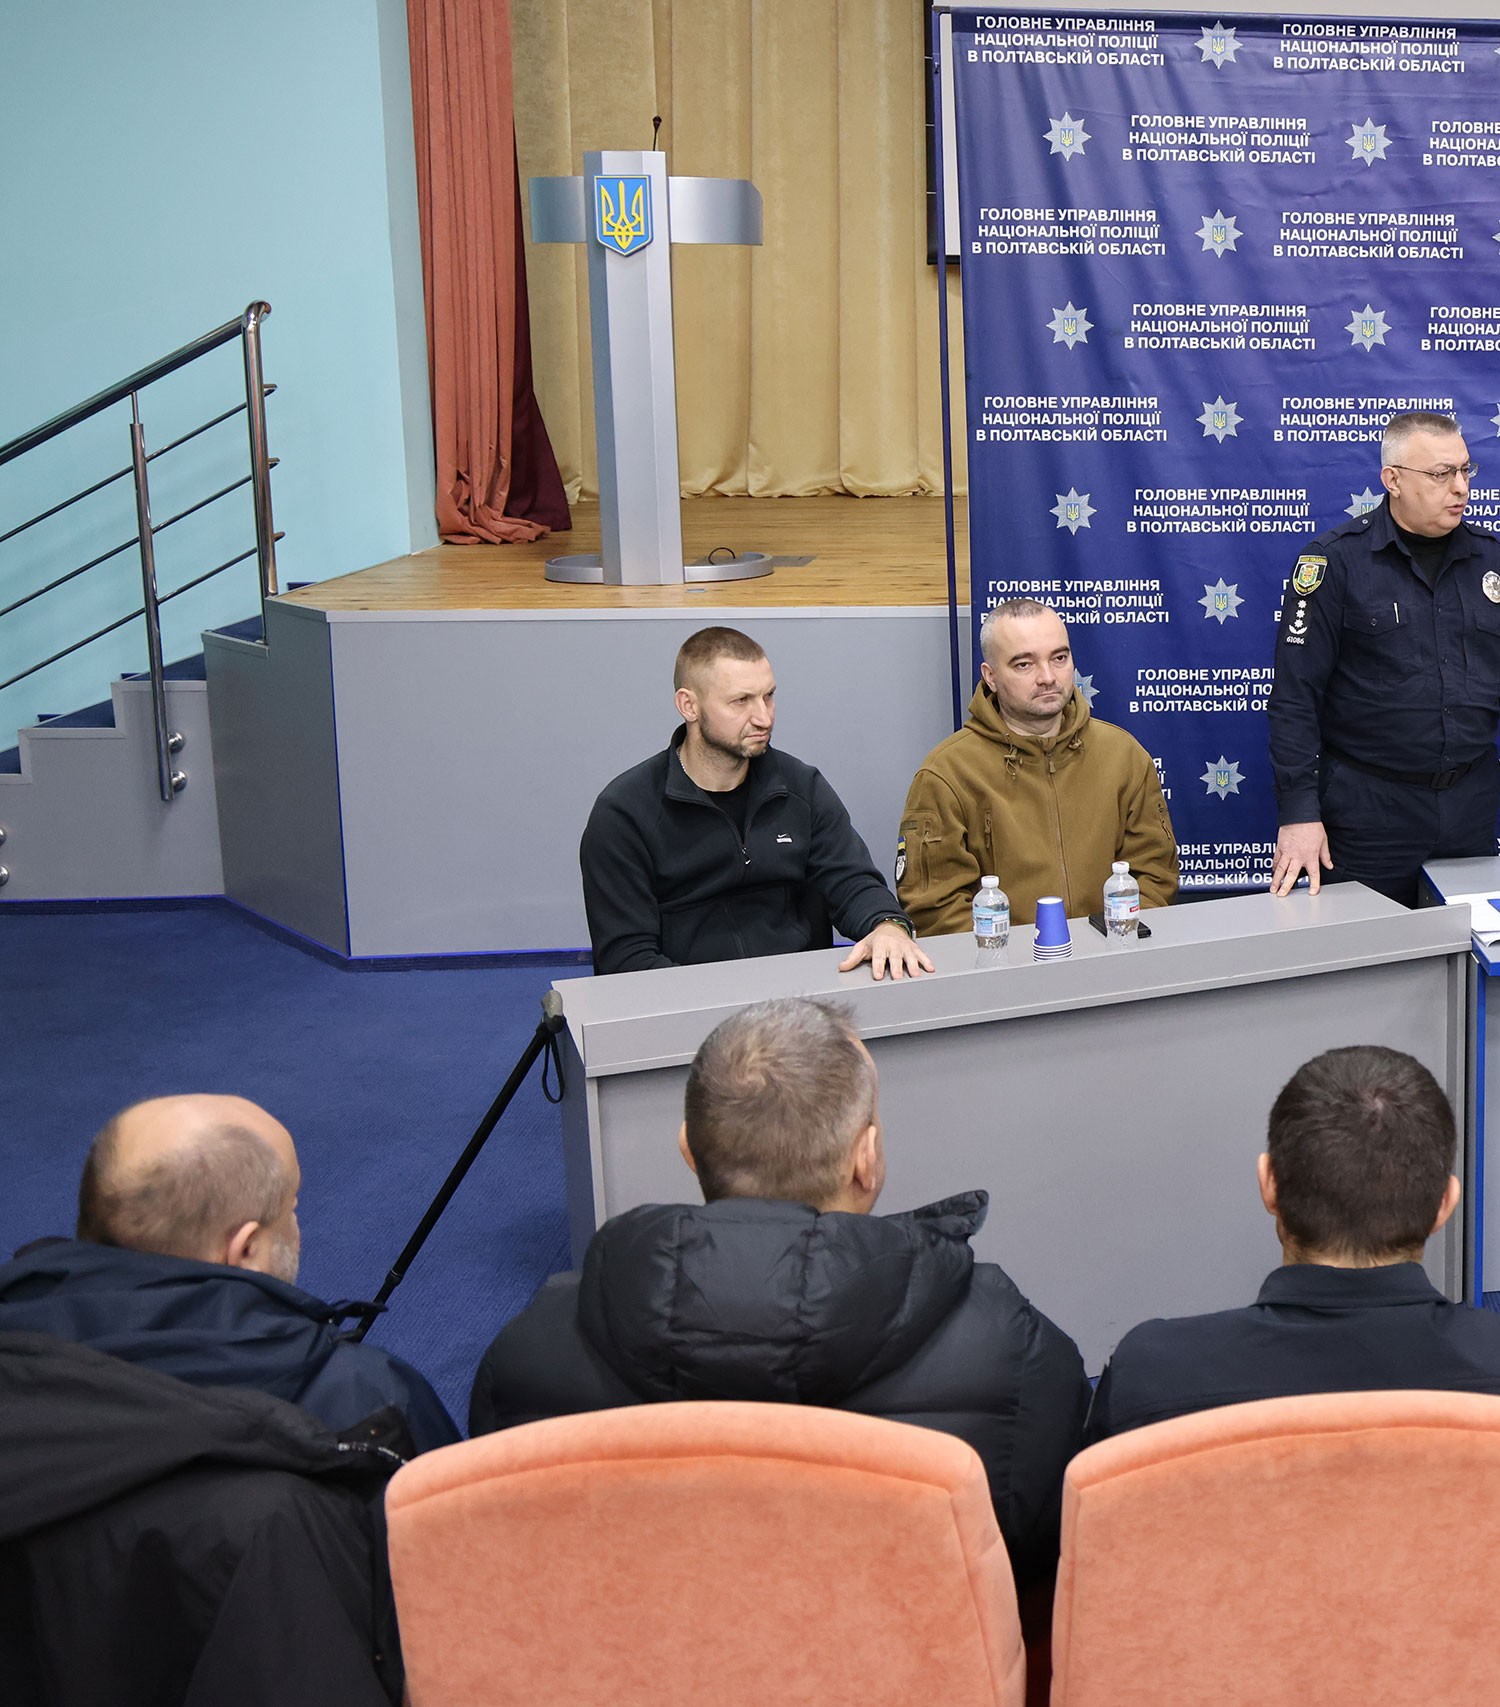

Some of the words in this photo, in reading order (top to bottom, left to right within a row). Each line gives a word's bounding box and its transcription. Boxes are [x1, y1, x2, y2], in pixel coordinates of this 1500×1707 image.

[976, 16, 1052, 29] ГОЛОВНЕ
[1055, 18, 1155, 32] УПРАВЛІННЯ
[1283, 24, 1356, 37] ГОЛОВНЕ
[1360, 26, 1456, 39] УПРАВЛІННЯ
[974, 33, 1096, 48] НАЦІОНАЛЬНОЇ
[1098, 34, 1159, 51] ПОЛІЦІЇ
[1280, 40, 1398, 55] НАЦІОНАЛЬНОЇ
[1400, 42, 1460, 58] ПОЛІЦІЇ
[968, 50, 978, 62] В
[982, 49, 1093, 64] ПОЛТАВСЬКІЙ
[1096, 52, 1164, 66] ОБЛАСТІ
[1273, 56, 1284, 68] В
[1287, 56, 1396, 71] ПОЛТАВСЬКІЙ
[1398, 59, 1465, 73] ОБЛАСТІ
[1131, 114, 1206, 128] ГОЛОВНЕ
[1208, 116, 1306, 130] УПРАВЛІННЯ
[1129, 131, 1248, 147] НАЦІОНАЛЬНОЇ
[1251, 132, 1311, 149] ПОЛІЦІЇ
[1122, 148, 1133, 160] В
[1136, 147, 1245, 162] ПОЛТАВСЬКІЙ
[1248, 150, 1315, 164] ОБЛАСТІ
[980, 208, 1055, 221] ГОЛОВНЕ
[1058, 209, 1156, 222] УПРАВЛІННЯ
[1282, 212, 1355, 225] ГОЛОВНЕ
[1358, 213, 1455, 226] УПРАВЛІННЯ
[978, 223, 1098, 239] НАЦІОНАЛЬНОЇ
[1100, 224, 1160, 241] ПОЛІЦІЇ
[1280, 227, 1397, 243] НАЦІОНАЛЬНОЇ
[1400, 228, 1459, 245] ПОЛІЦІЇ
[972, 242, 982, 254] В
[986, 240, 1094, 255] ПОЛТАВСЬКІЙ
[1098, 242, 1165, 255] ОБЛАСТІ
[1273, 245, 1284, 257] В
[1287, 244, 1394, 258] ПОЛТАВСЬКІЙ
[1397, 246, 1463, 259] ОБЛАСТІ
[1133, 304, 1206, 316] ГОЛОВНЕ
[1209, 304, 1306, 317] УПРАВЛІННЯ
[1131, 318, 1249, 334] НАЦІОНАЛЬНОЇ
[1251, 319, 1310, 336] ПОЛІЦІЇ
[1124, 337, 1134, 348] В
[1138, 335, 1245, 349] ПОЛТАВСЬКІЙ
[1249, 337, 1315, 350] ОБЛАСТІ
[985, 396, 1058, 408] ГОЛОВНЕ
[1060, 396, 1158, 409] УПРАВЛІННЯ
[1283, 397, 1355, 409] ГОЛОВНЕ
[1357, 398, 1453, 410] УПРАВЛІННЯ
[983, 410, 1100, 427] НАЦІОНАЛЬНОЇ
[1103, 411, 1162, 427] ПОЛІЦІЇ
[976, 429, 986, 441] В
[990, 427, 1097, 441] ПОЛТАВСЬКІЙ
[1101, 429, 1167, 441] ОБЛАСТІ
[1274, 430, 1284, 441] В
[1135, 489, 1207, 501] ГОЛОВНЕ
[1210, 489, 1306, 500] УПРАВЛІННЯ
[1133, 502, 1248, 519] НАЦІОНАЛЬНОЇ
[1252, 502, 1310, 518] ПОЛІЦІЇ
[1127, 521, 1137, 532] В
[1141, 518, 1246, 533] ПОЛТАВСЬКІЙ
[1250, 521, 1315, 532] ОБЛАСТІ
[989, 580, 1061, 592] ГОЛОВНЕ
[1064, 579, 1159, 592] УПРАВЛІННЯ
[1106, 593, 1163, 609] ПОЛІЦІЇ
[1104, 611, 1169, 624] ОБЛАСТІ
[1138, 669, 1209, 681] ГОЛОВНЕ
[1212, 668, 1275, 680] УПРАВЛІ
[1136, 682, 1249, 698] НАЦІОНАЛЬНОЇ
[1130, 701, 1139, 713] В
[1143, 698, 1247, 712] ПОЛТАВСЬКІЙ
